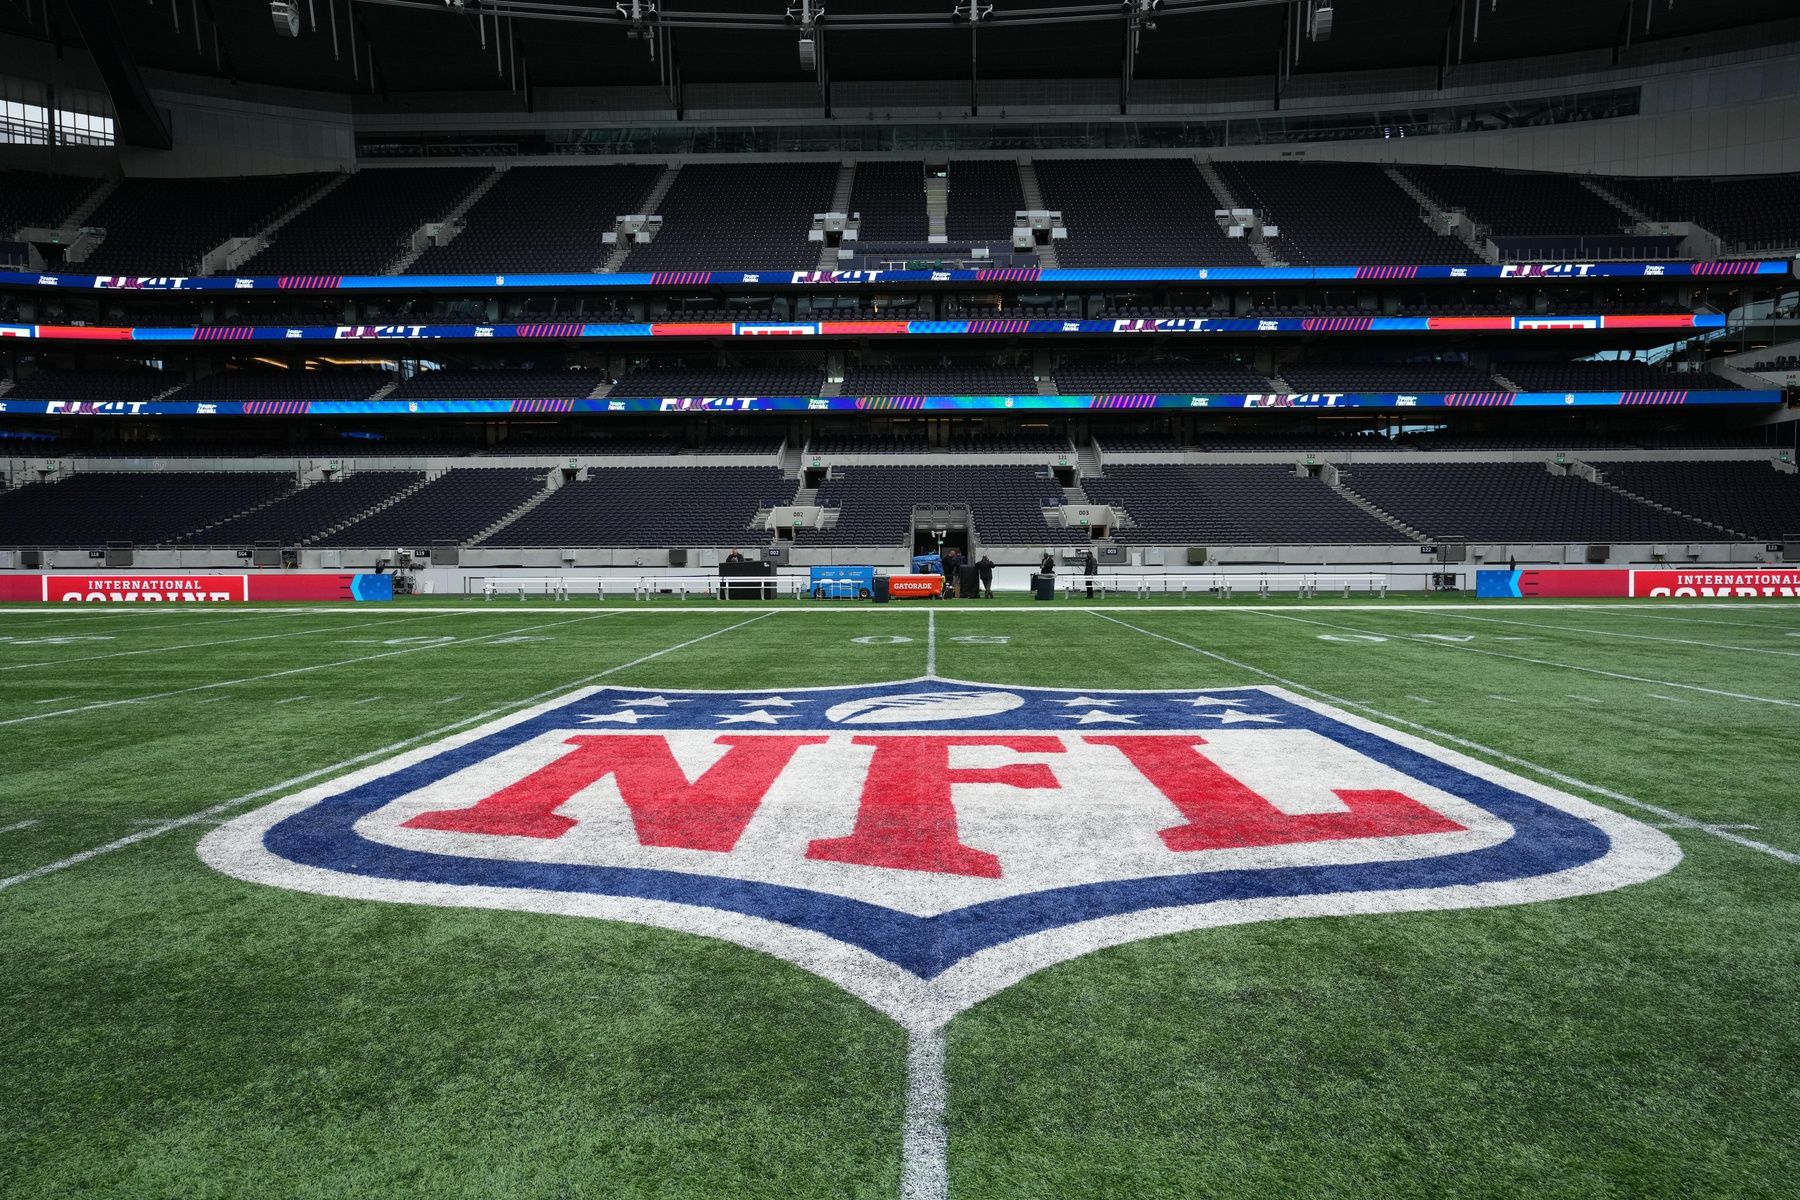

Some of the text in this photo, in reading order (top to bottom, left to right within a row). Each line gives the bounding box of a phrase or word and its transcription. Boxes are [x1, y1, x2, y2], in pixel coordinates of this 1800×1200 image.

[88, 580, 202, 590] INTERNATIONAL
[1677, 575, 1800, 585] INTERNATIONAL
[893, 582, 932, 590] GATORADE
[399, 735, 1469, 879] NFL
